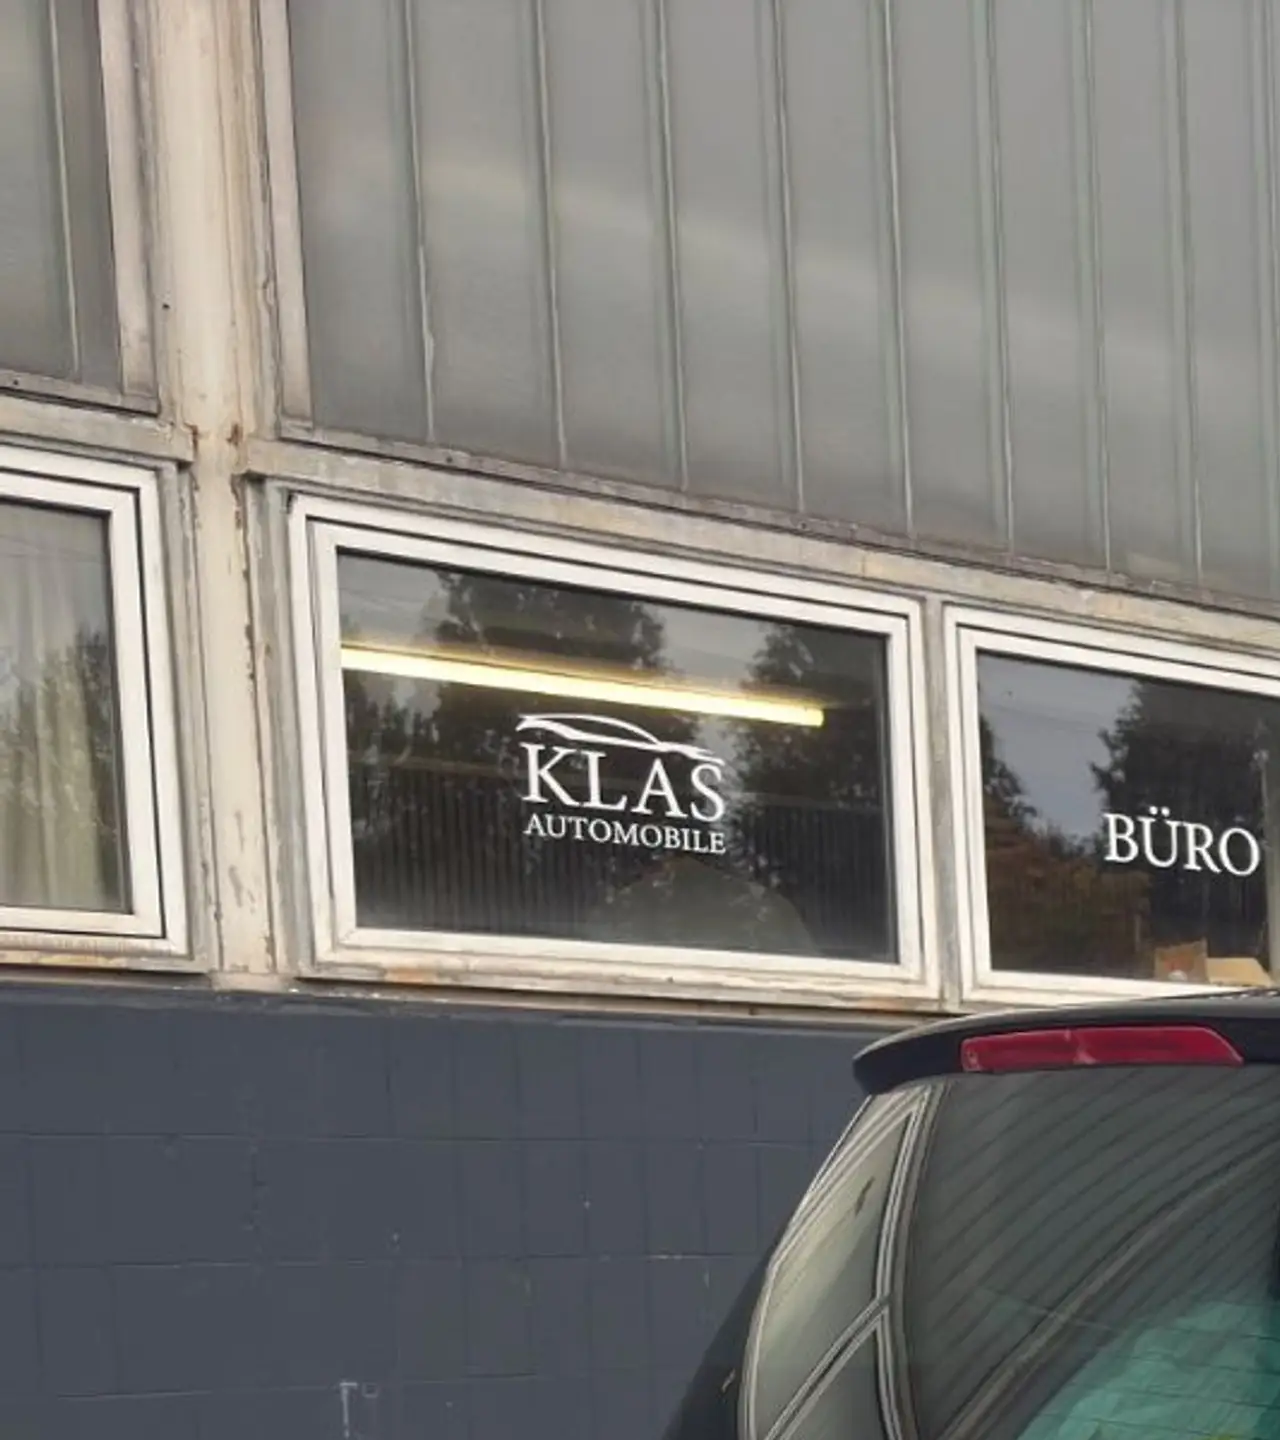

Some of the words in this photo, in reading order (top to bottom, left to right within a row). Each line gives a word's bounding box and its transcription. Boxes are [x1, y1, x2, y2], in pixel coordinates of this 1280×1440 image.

[519, 742, 726, 823] KLAS
[523, 813, 727, 854] AUTOMOBILE
[1104, 806, 1261, 877] BÜRO
